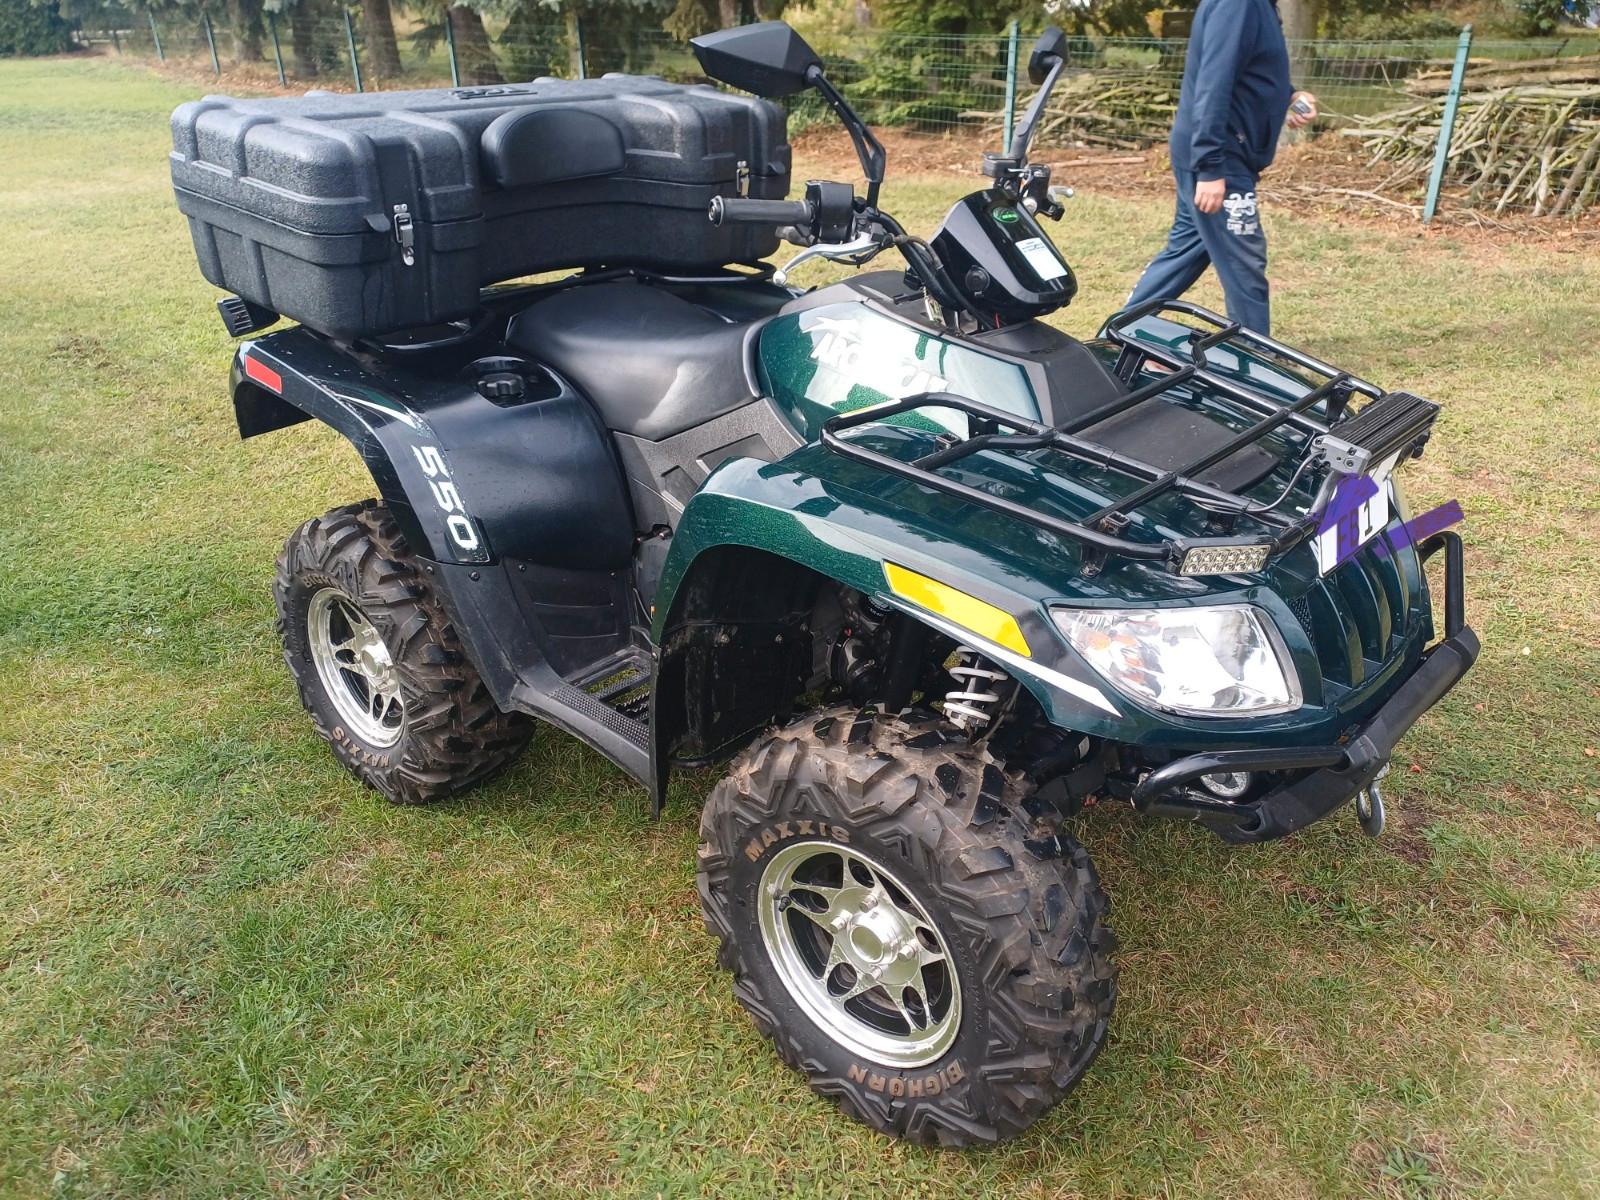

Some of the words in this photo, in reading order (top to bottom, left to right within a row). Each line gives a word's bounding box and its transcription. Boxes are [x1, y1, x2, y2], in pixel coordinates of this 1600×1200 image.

[411, 444, 479, 550] 550
[332, 726, 390, 768] MAXXIS
[744, 819, 852, 863] MAXXIS
[847, 1058, 967, 1099] BIGHORN
